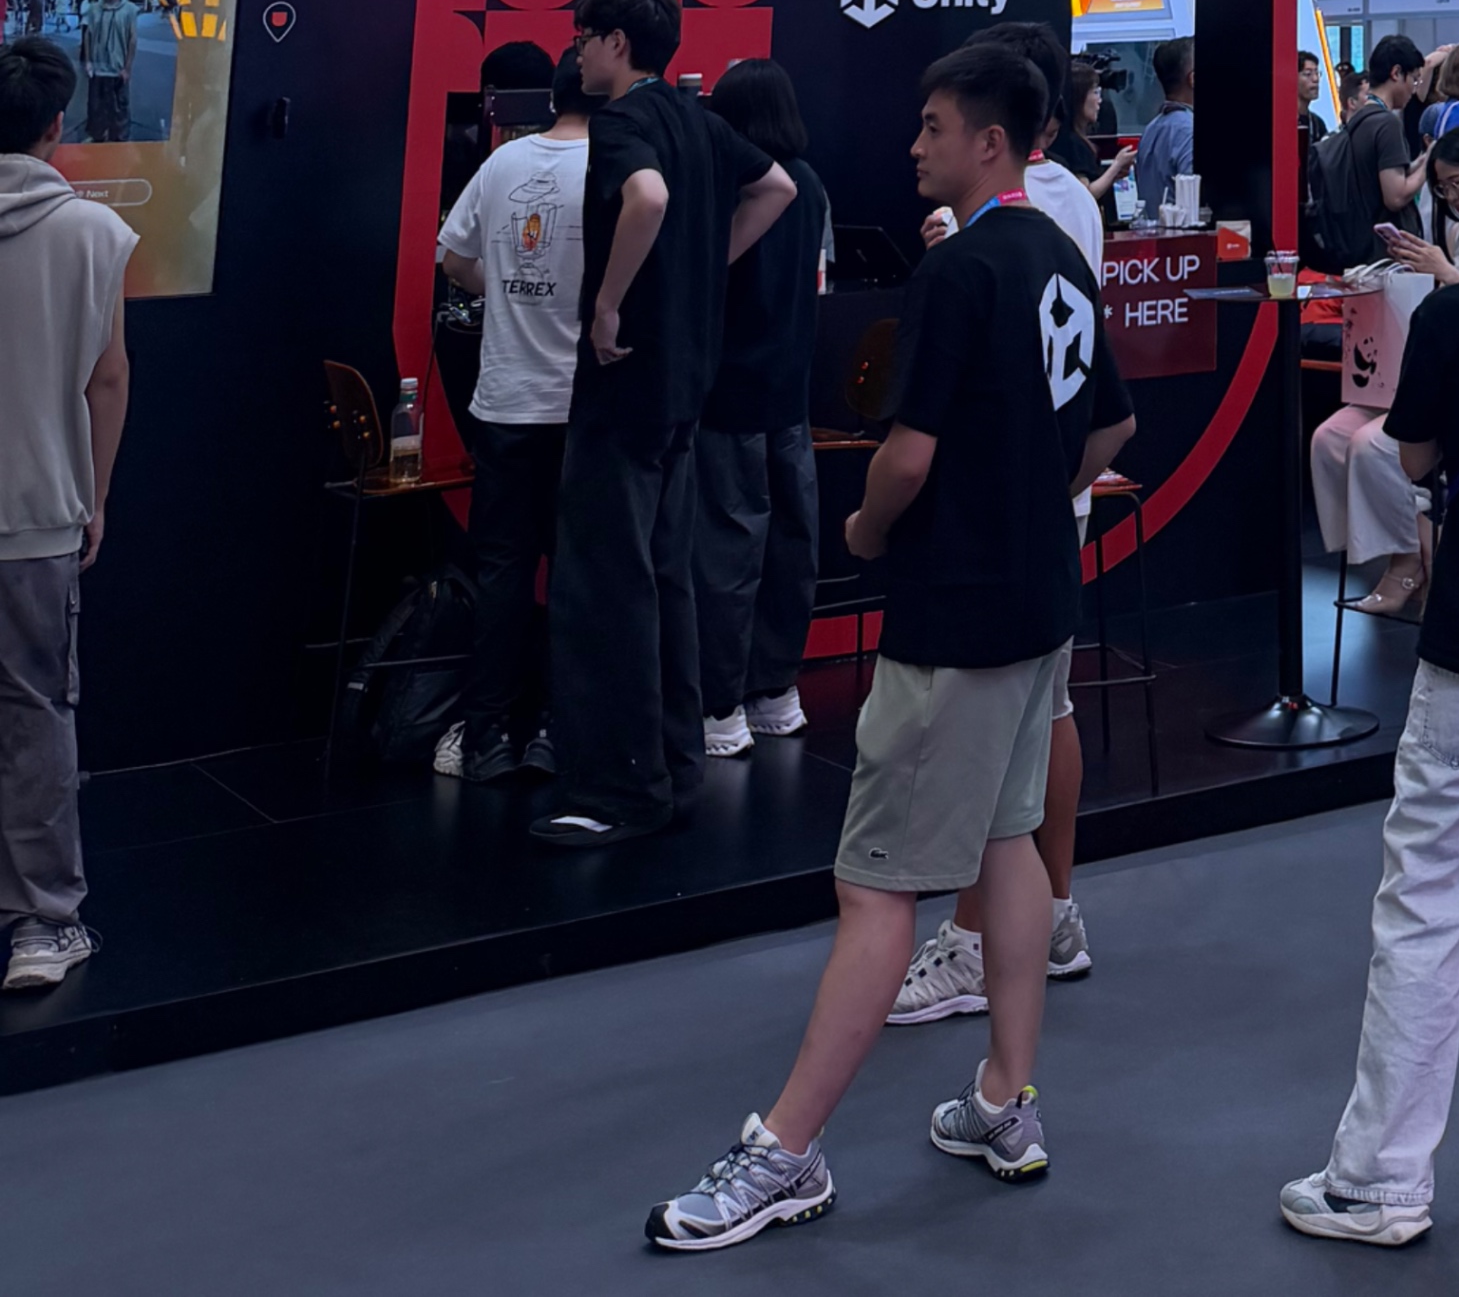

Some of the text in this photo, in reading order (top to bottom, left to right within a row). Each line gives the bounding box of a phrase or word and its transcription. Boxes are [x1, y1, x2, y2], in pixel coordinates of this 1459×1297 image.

[1102, 254, 1201, 286] PICK UP
[502, 278, 556, 298] TERREX
[1125, 297, 1189, 328] HERE
